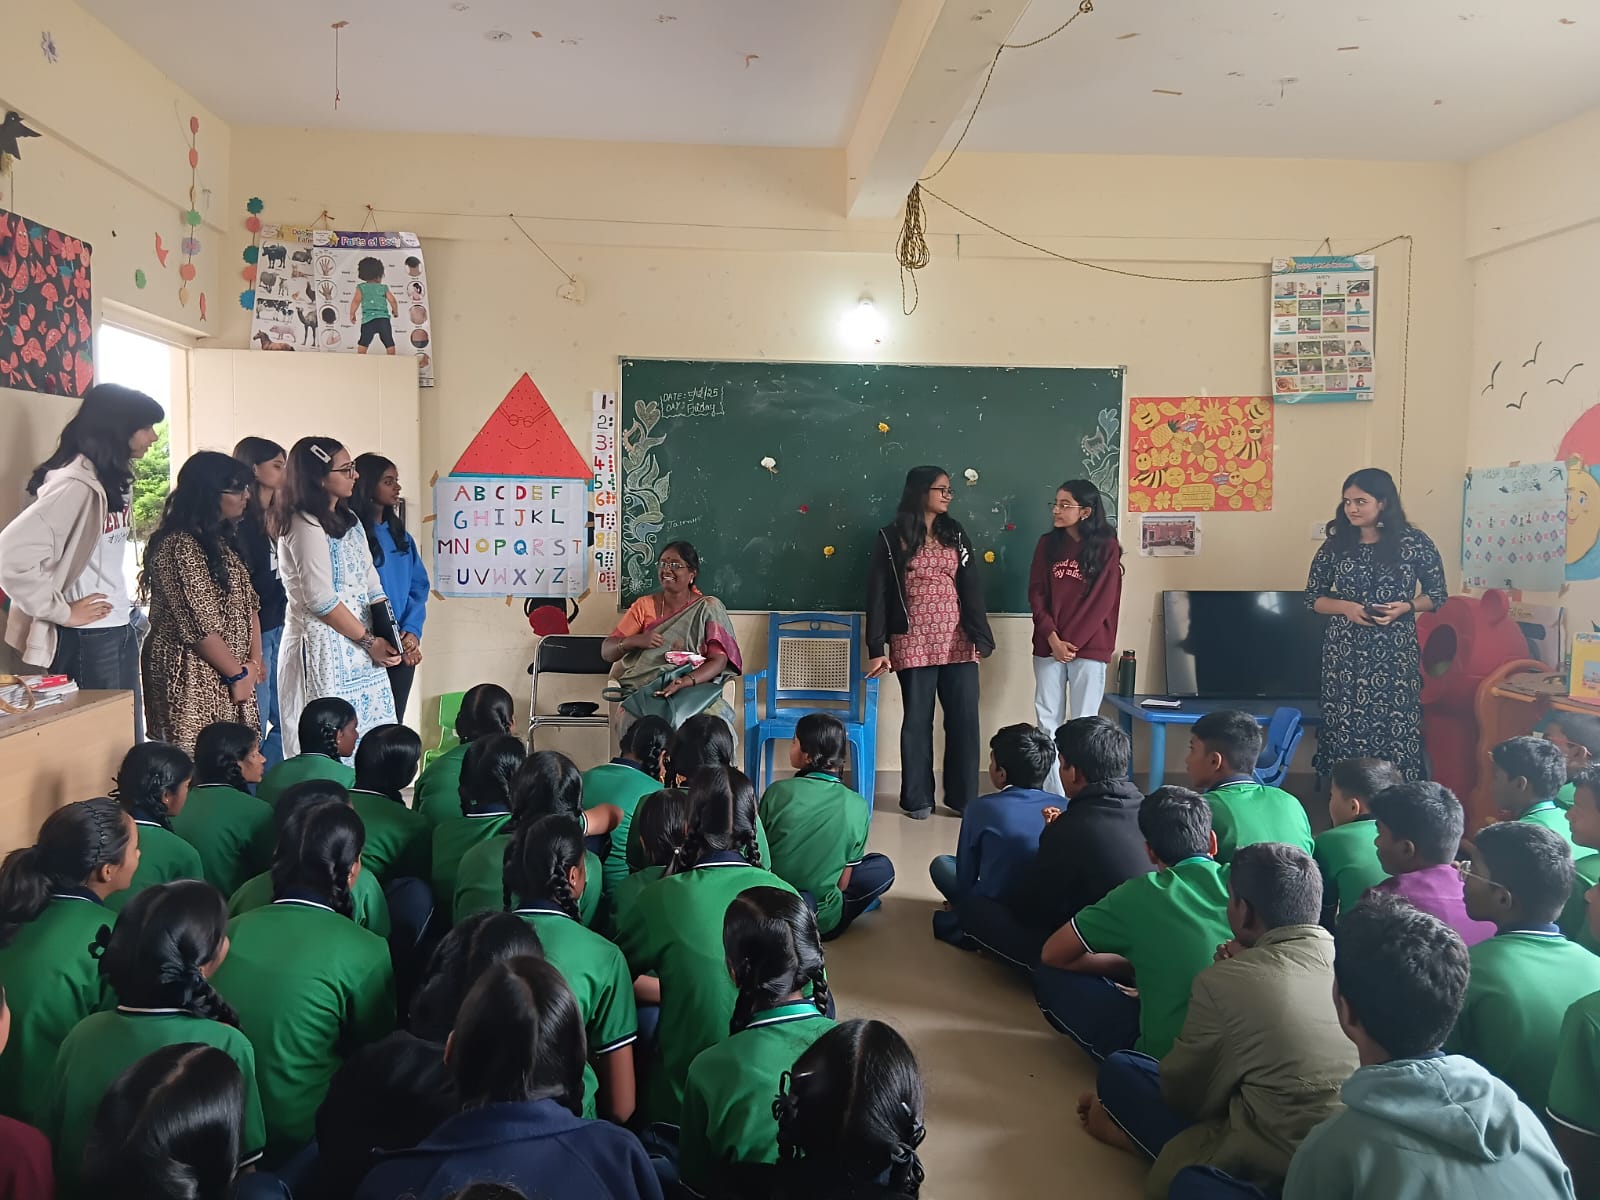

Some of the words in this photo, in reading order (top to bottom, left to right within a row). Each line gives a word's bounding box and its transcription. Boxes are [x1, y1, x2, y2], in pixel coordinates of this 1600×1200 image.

[341, 236, 366, 246] Parts
[368, 237, 377, 246] of
[379, 237, 401, 248] Body
[602, 395, 606, 409] 1
[663, 392, 686, 402] DATE:
[687, 402, 716, 416] Friday
[598, 415, 608, 429] 2
[596, 435, 607, 450] 3
[594, 456, 604, 470] 4
[595, 474, 602, 489] 5
[454, 486, 471, 501] A
[474, 486, 485, 500] B
[496, 486, 504, 500] C
[516, 486, 527, 500] D
[532, 486, 542, 500] E
[552, 486, 562, 499] F
[596, 492, 604, 506] 6
[454, 511, 467, 529] G
[474, 511, 488, 526] H
[495, 509, 504, 525] I
[515, 509, 526, 526] J
[532, 510, 543, 524] K
[552, 509, 564, 524] L
[595, 514, 604, 528] 7
[438, 540, 452, 554] M
[455, 538, 468, 554] N
[476, 539, 489, 552] O
[495, 540, 506, 555] P
[514, 540, 528, 555] Q
[533, 539, 544, 556] R
[553, 540, 565, 556] S
[573, 540, 581, 554] T
[596, 532, 604, 548] 8
[595, 552, 603, 567] 9
[458, 568, 469, 585] U
[475, 568, 490, 585] V
[494, 568, 506, 584] W
[513, 569, 527, 585] X
[535, 568, 544, 584] Y
[552, 568, 566, 583] Z
[1054, 568, 1064, 578] my
